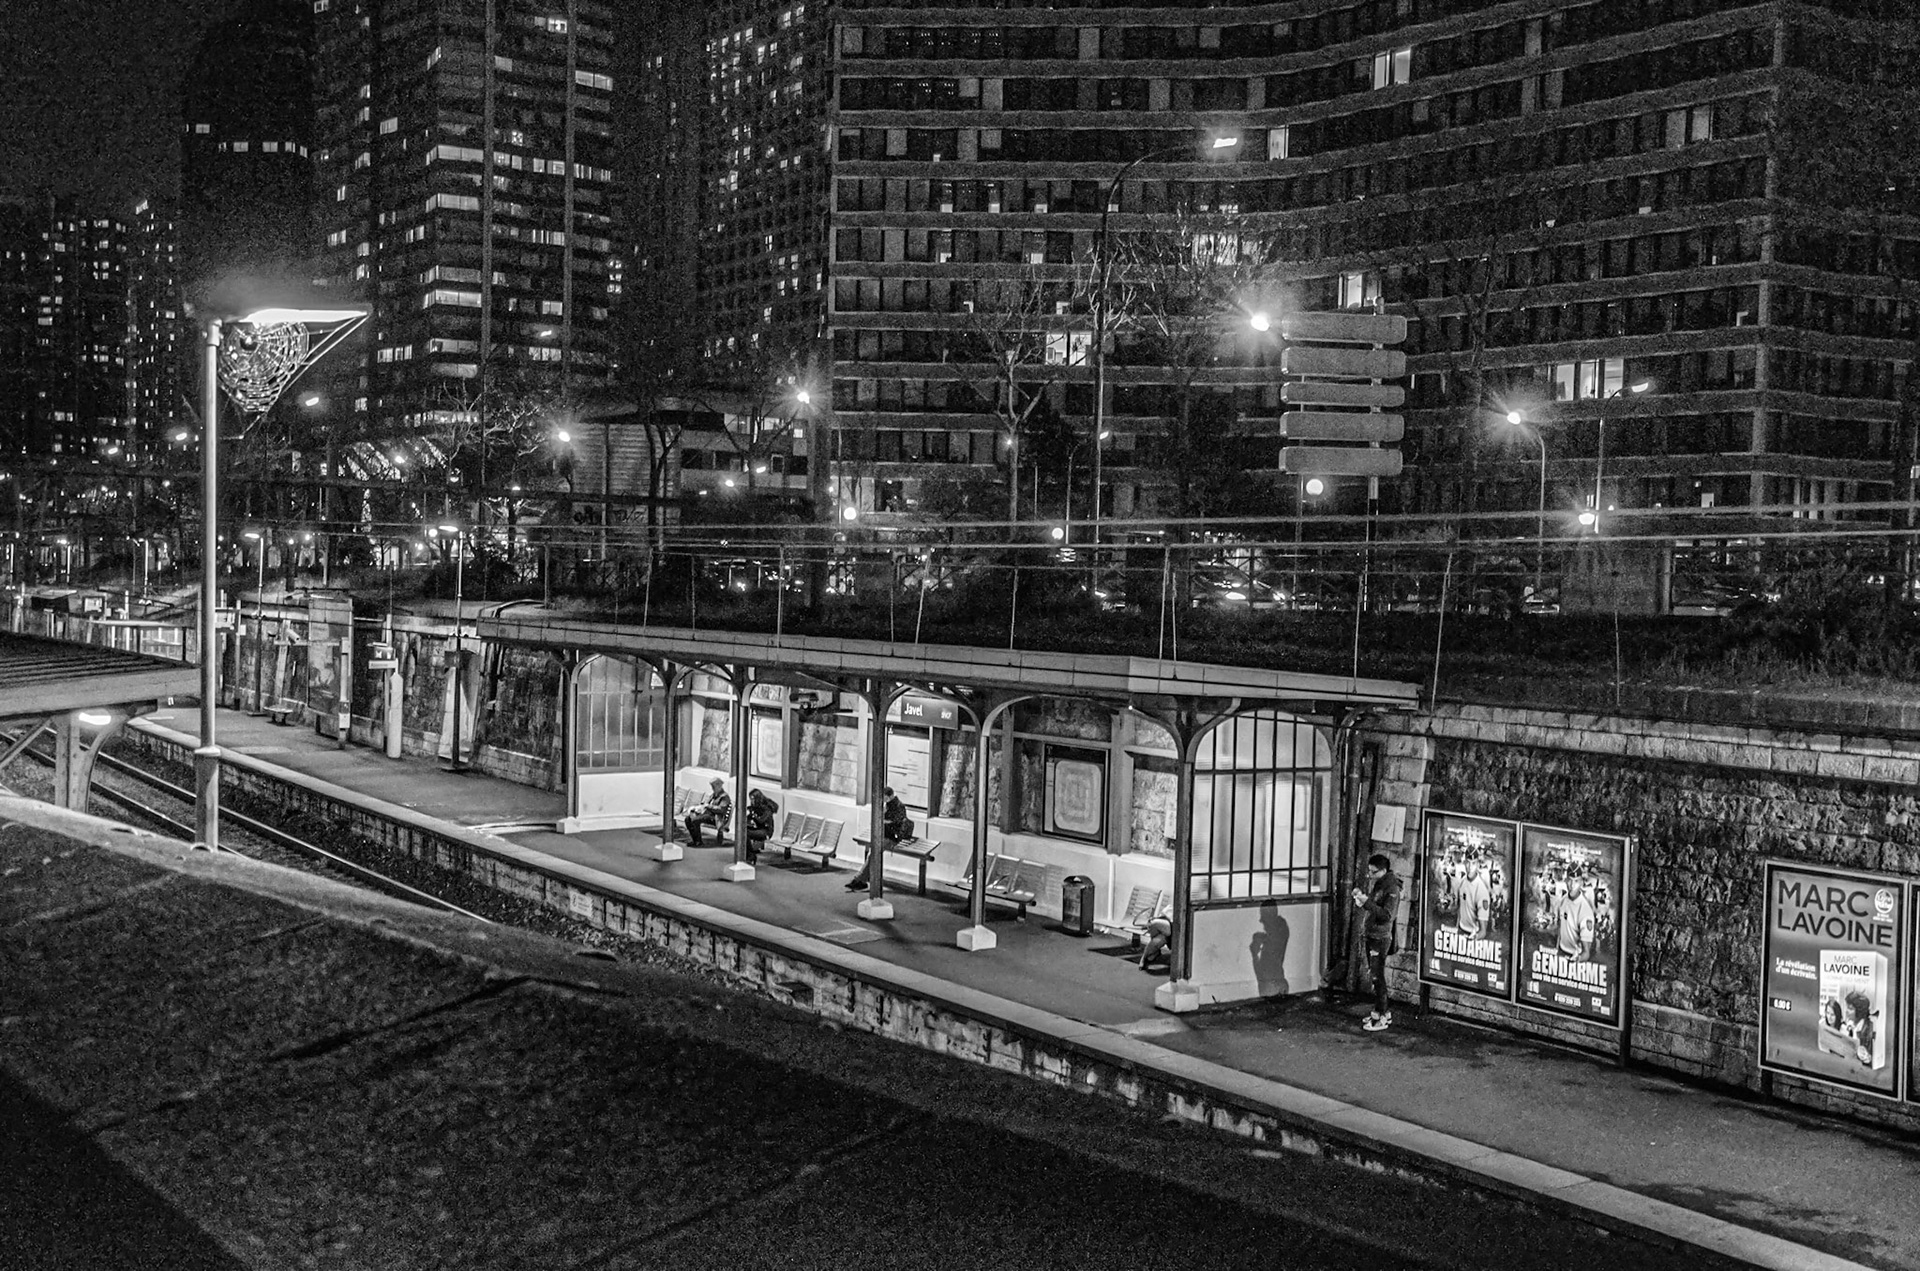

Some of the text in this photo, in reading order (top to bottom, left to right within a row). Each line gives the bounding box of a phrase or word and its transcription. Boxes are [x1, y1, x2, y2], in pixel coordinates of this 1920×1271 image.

[904, 702, 923, 717] Javel
[1778, 879, 1870, 917] MARC
[1777, 908, 1893, 947] LAVOINE
[1434, 928, 1502, 963] GENDARME
[1532, 949, 1607, 987] GENDARME
[1776, 956, 1785, 967] La
[1823, 963, 1870, 977] LAVOINE
[1833, 955, 1857, 965] MARC
